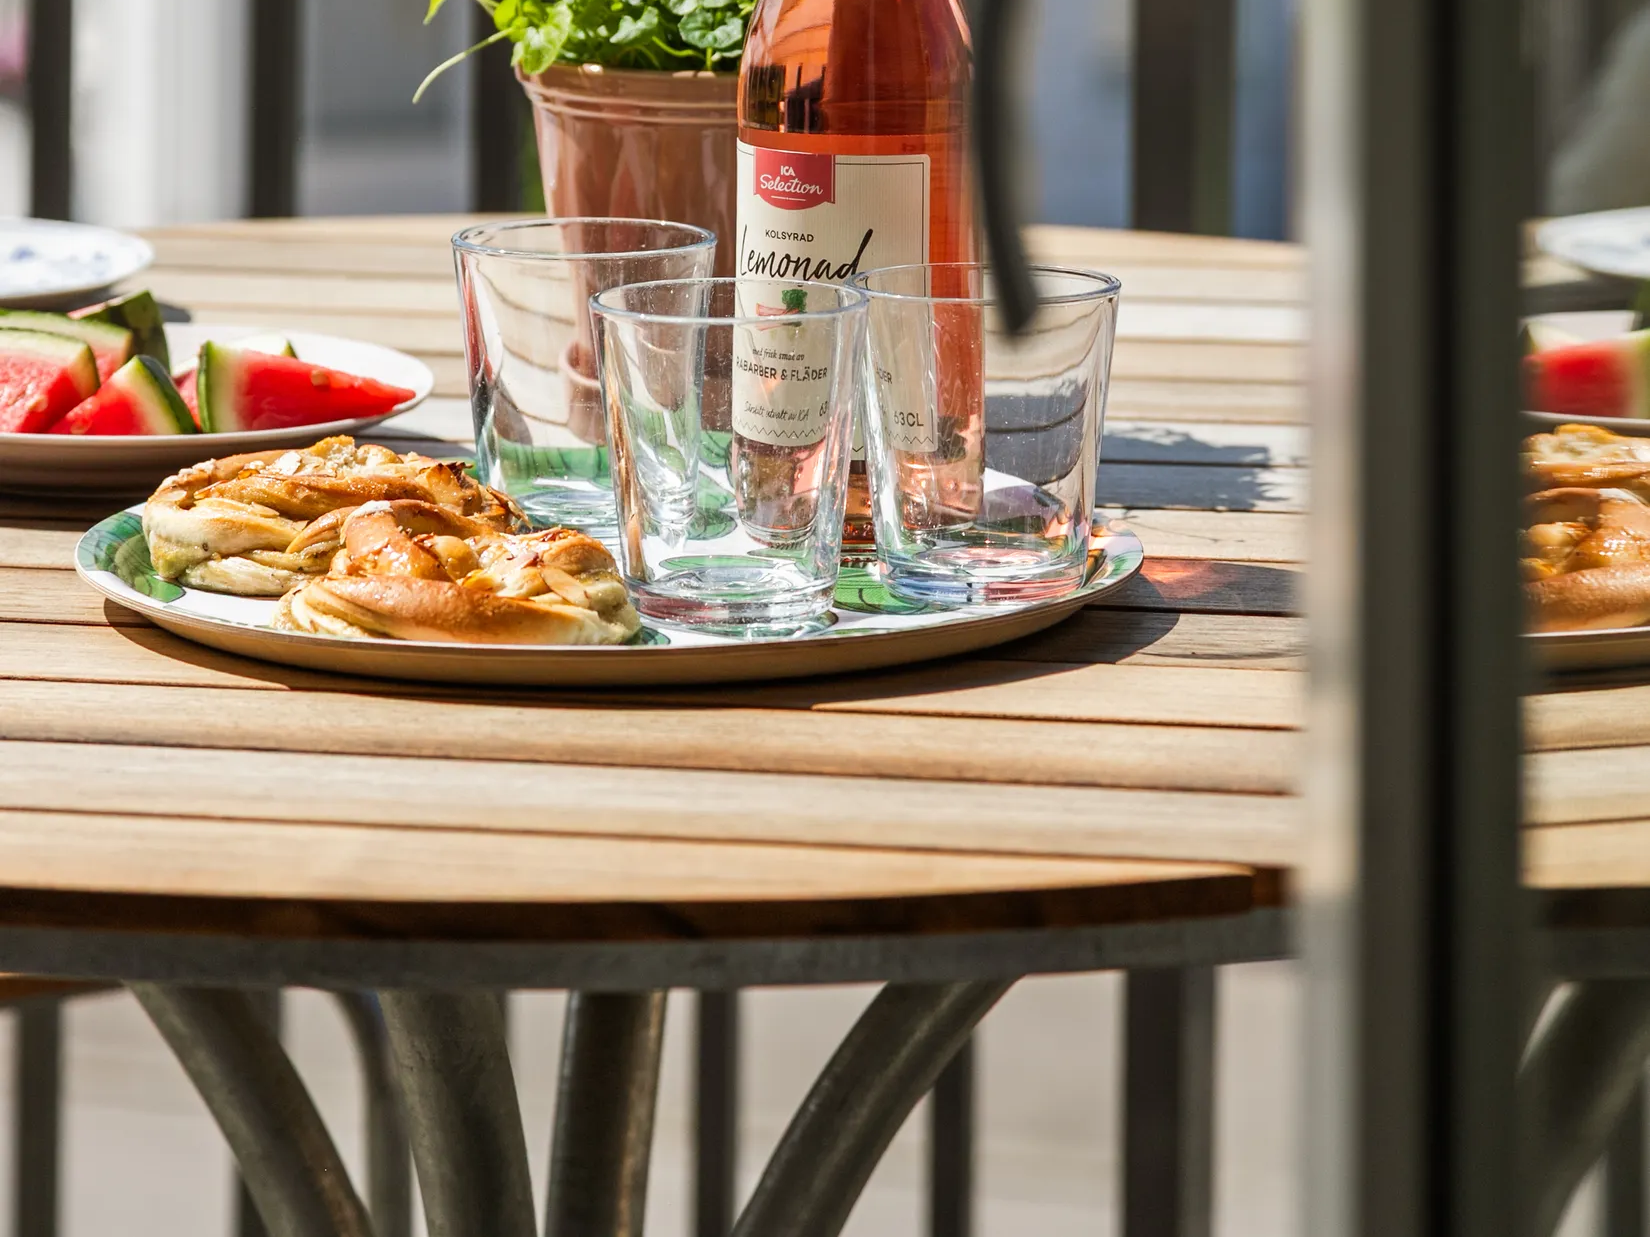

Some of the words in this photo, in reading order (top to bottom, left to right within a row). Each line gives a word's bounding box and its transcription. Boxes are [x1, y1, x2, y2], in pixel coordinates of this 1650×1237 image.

[780, 165, 796, 176] ICA
[760, 174, 823, 195] Selection
[765, 229, 814, 242] KOLSYRAD
[740, 224, 873, 281] Lemonad
[780, 368, 788, 381] &
[790, 366, 828, 381] FLÄDER
